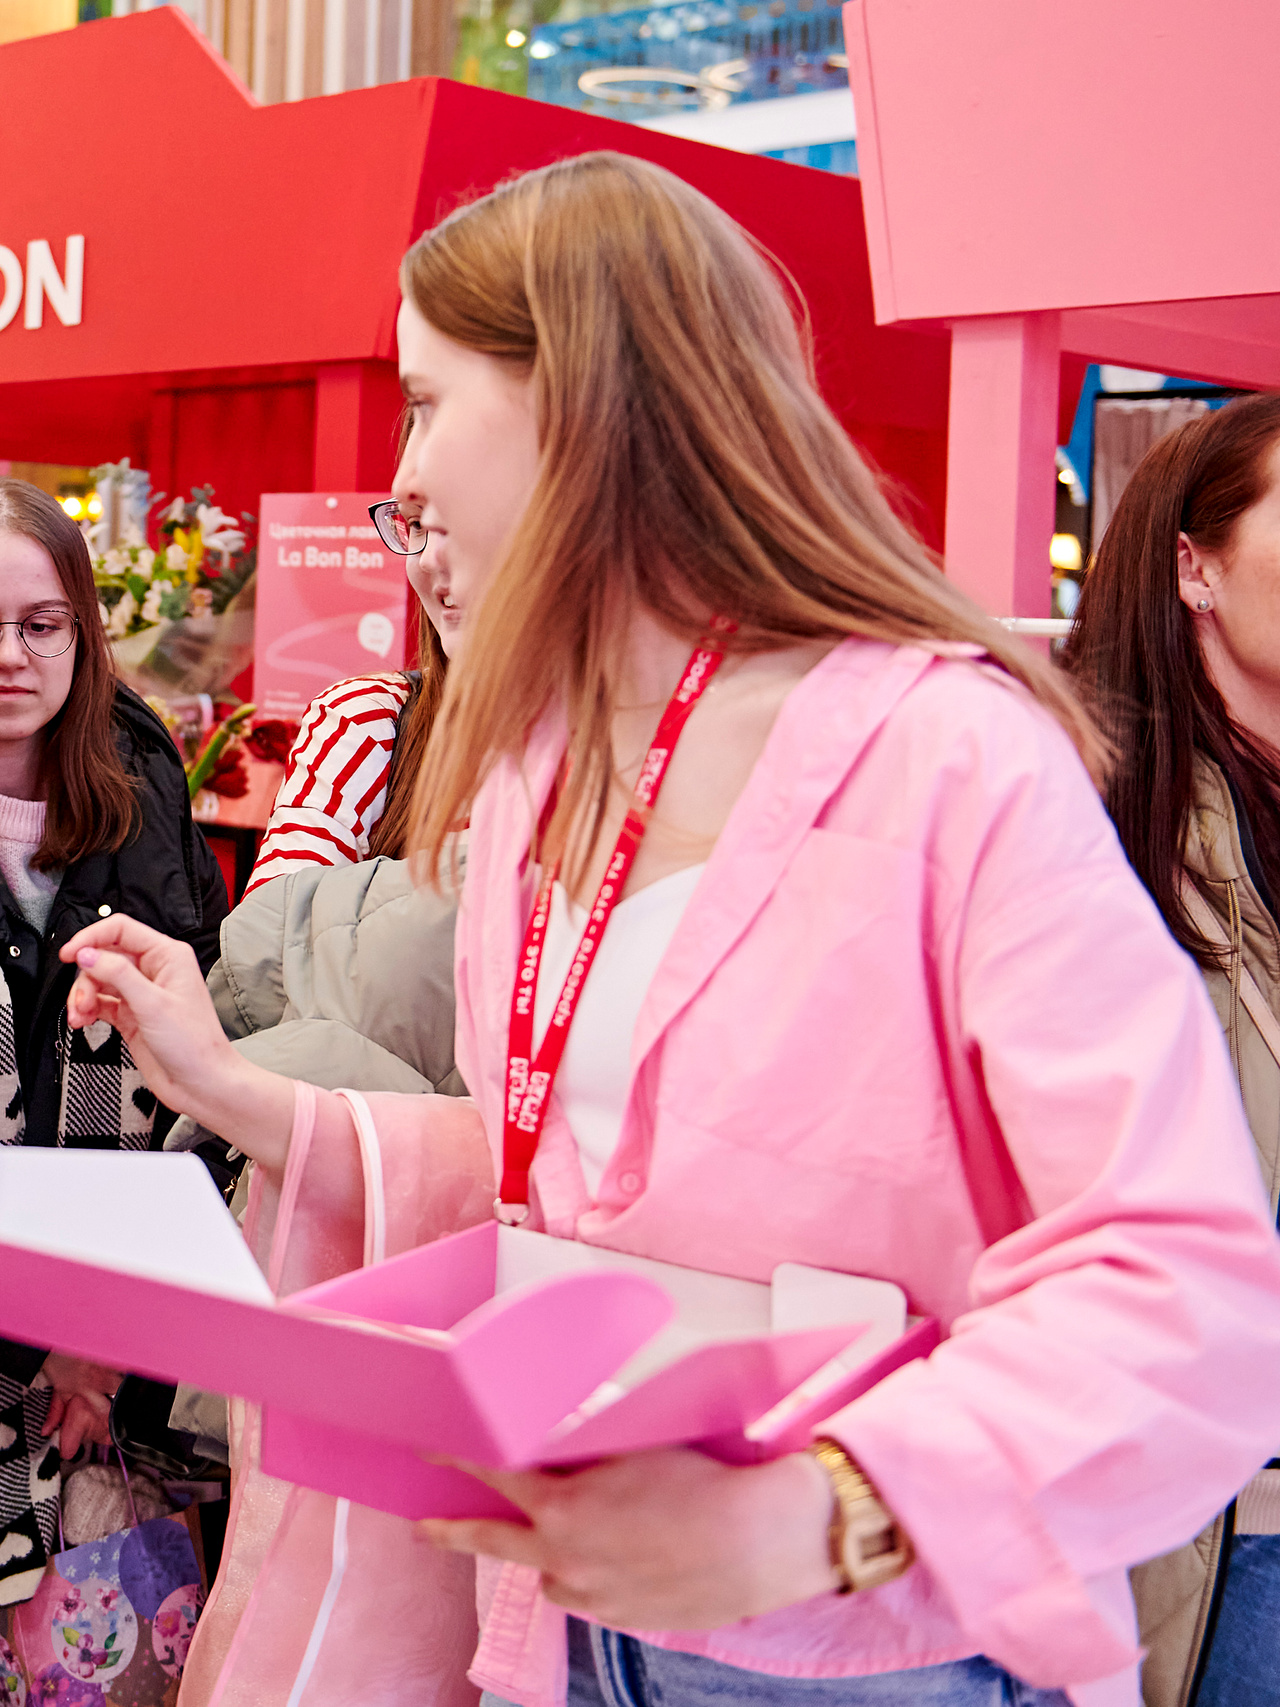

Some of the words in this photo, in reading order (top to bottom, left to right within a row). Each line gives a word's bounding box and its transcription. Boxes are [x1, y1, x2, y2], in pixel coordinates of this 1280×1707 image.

[277, 545, 302, 568] La
[304, 545, 342, 569] Bon
[345, 545, 384, 570] Bon
[552, 936, 594, 1027] красота
[591, 883, 614, 923] это
[606, 851, 626, 880] ты
[520, 944, 540, 982] это
[516, 984, 533, 1015] ты
